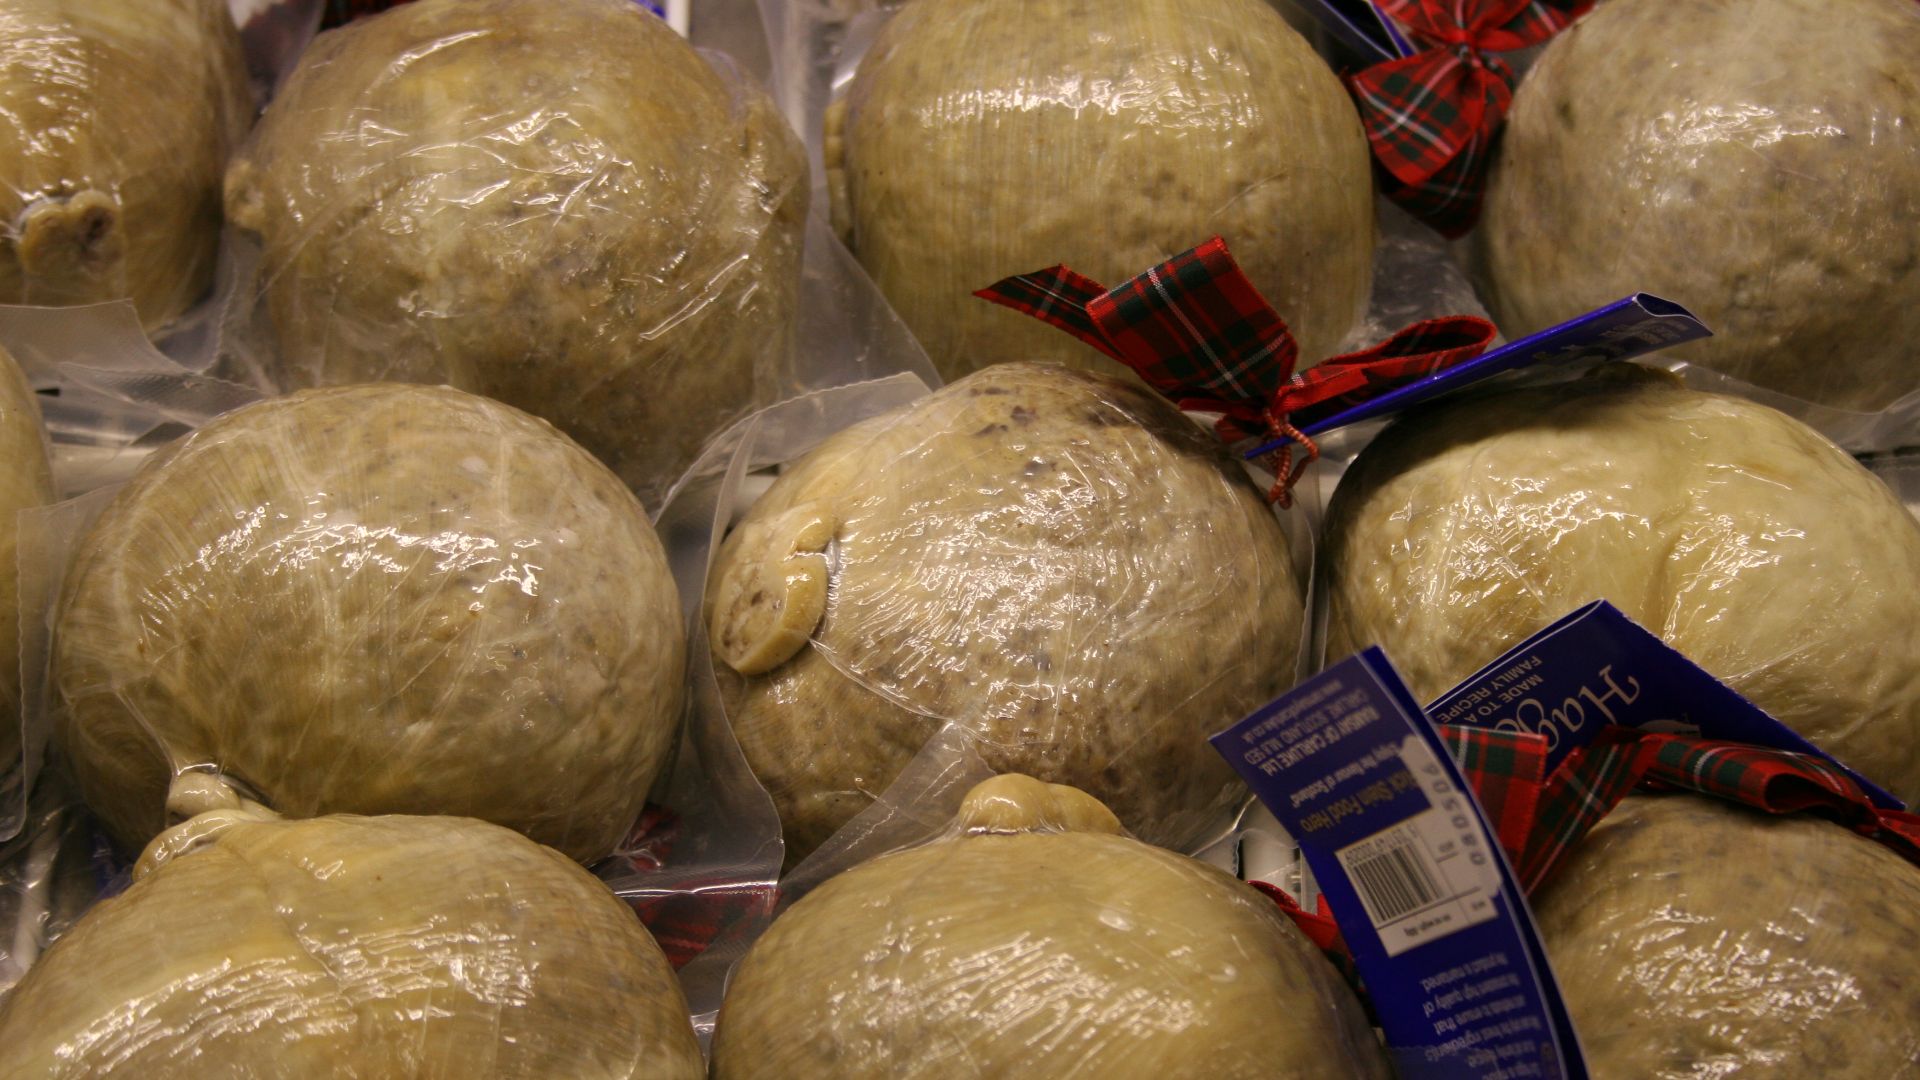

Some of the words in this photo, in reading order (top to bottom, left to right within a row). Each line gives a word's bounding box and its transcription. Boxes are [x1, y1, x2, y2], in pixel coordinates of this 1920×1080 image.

[1490, 655, 1542, 691] FAMILY
[1497, 673, 1543, 705] MADE
[1435, 686, 1491, 723] RECIPE
[1462, 711, 1474, 724] A
[1477, 699, 1503, 717] TO
[1335, 705, 1381, 737] RAMSAY
[1323, 726, 1341, 745] OF
[1277, 734, 1328, 770] CARLUKE
[1300, 808, 1334, 834] Hero
[1328, 796, 1364, 825] Food
[1422, 1001, 1435, 1018] of
[1433, 1017, 1457, 1036] that
